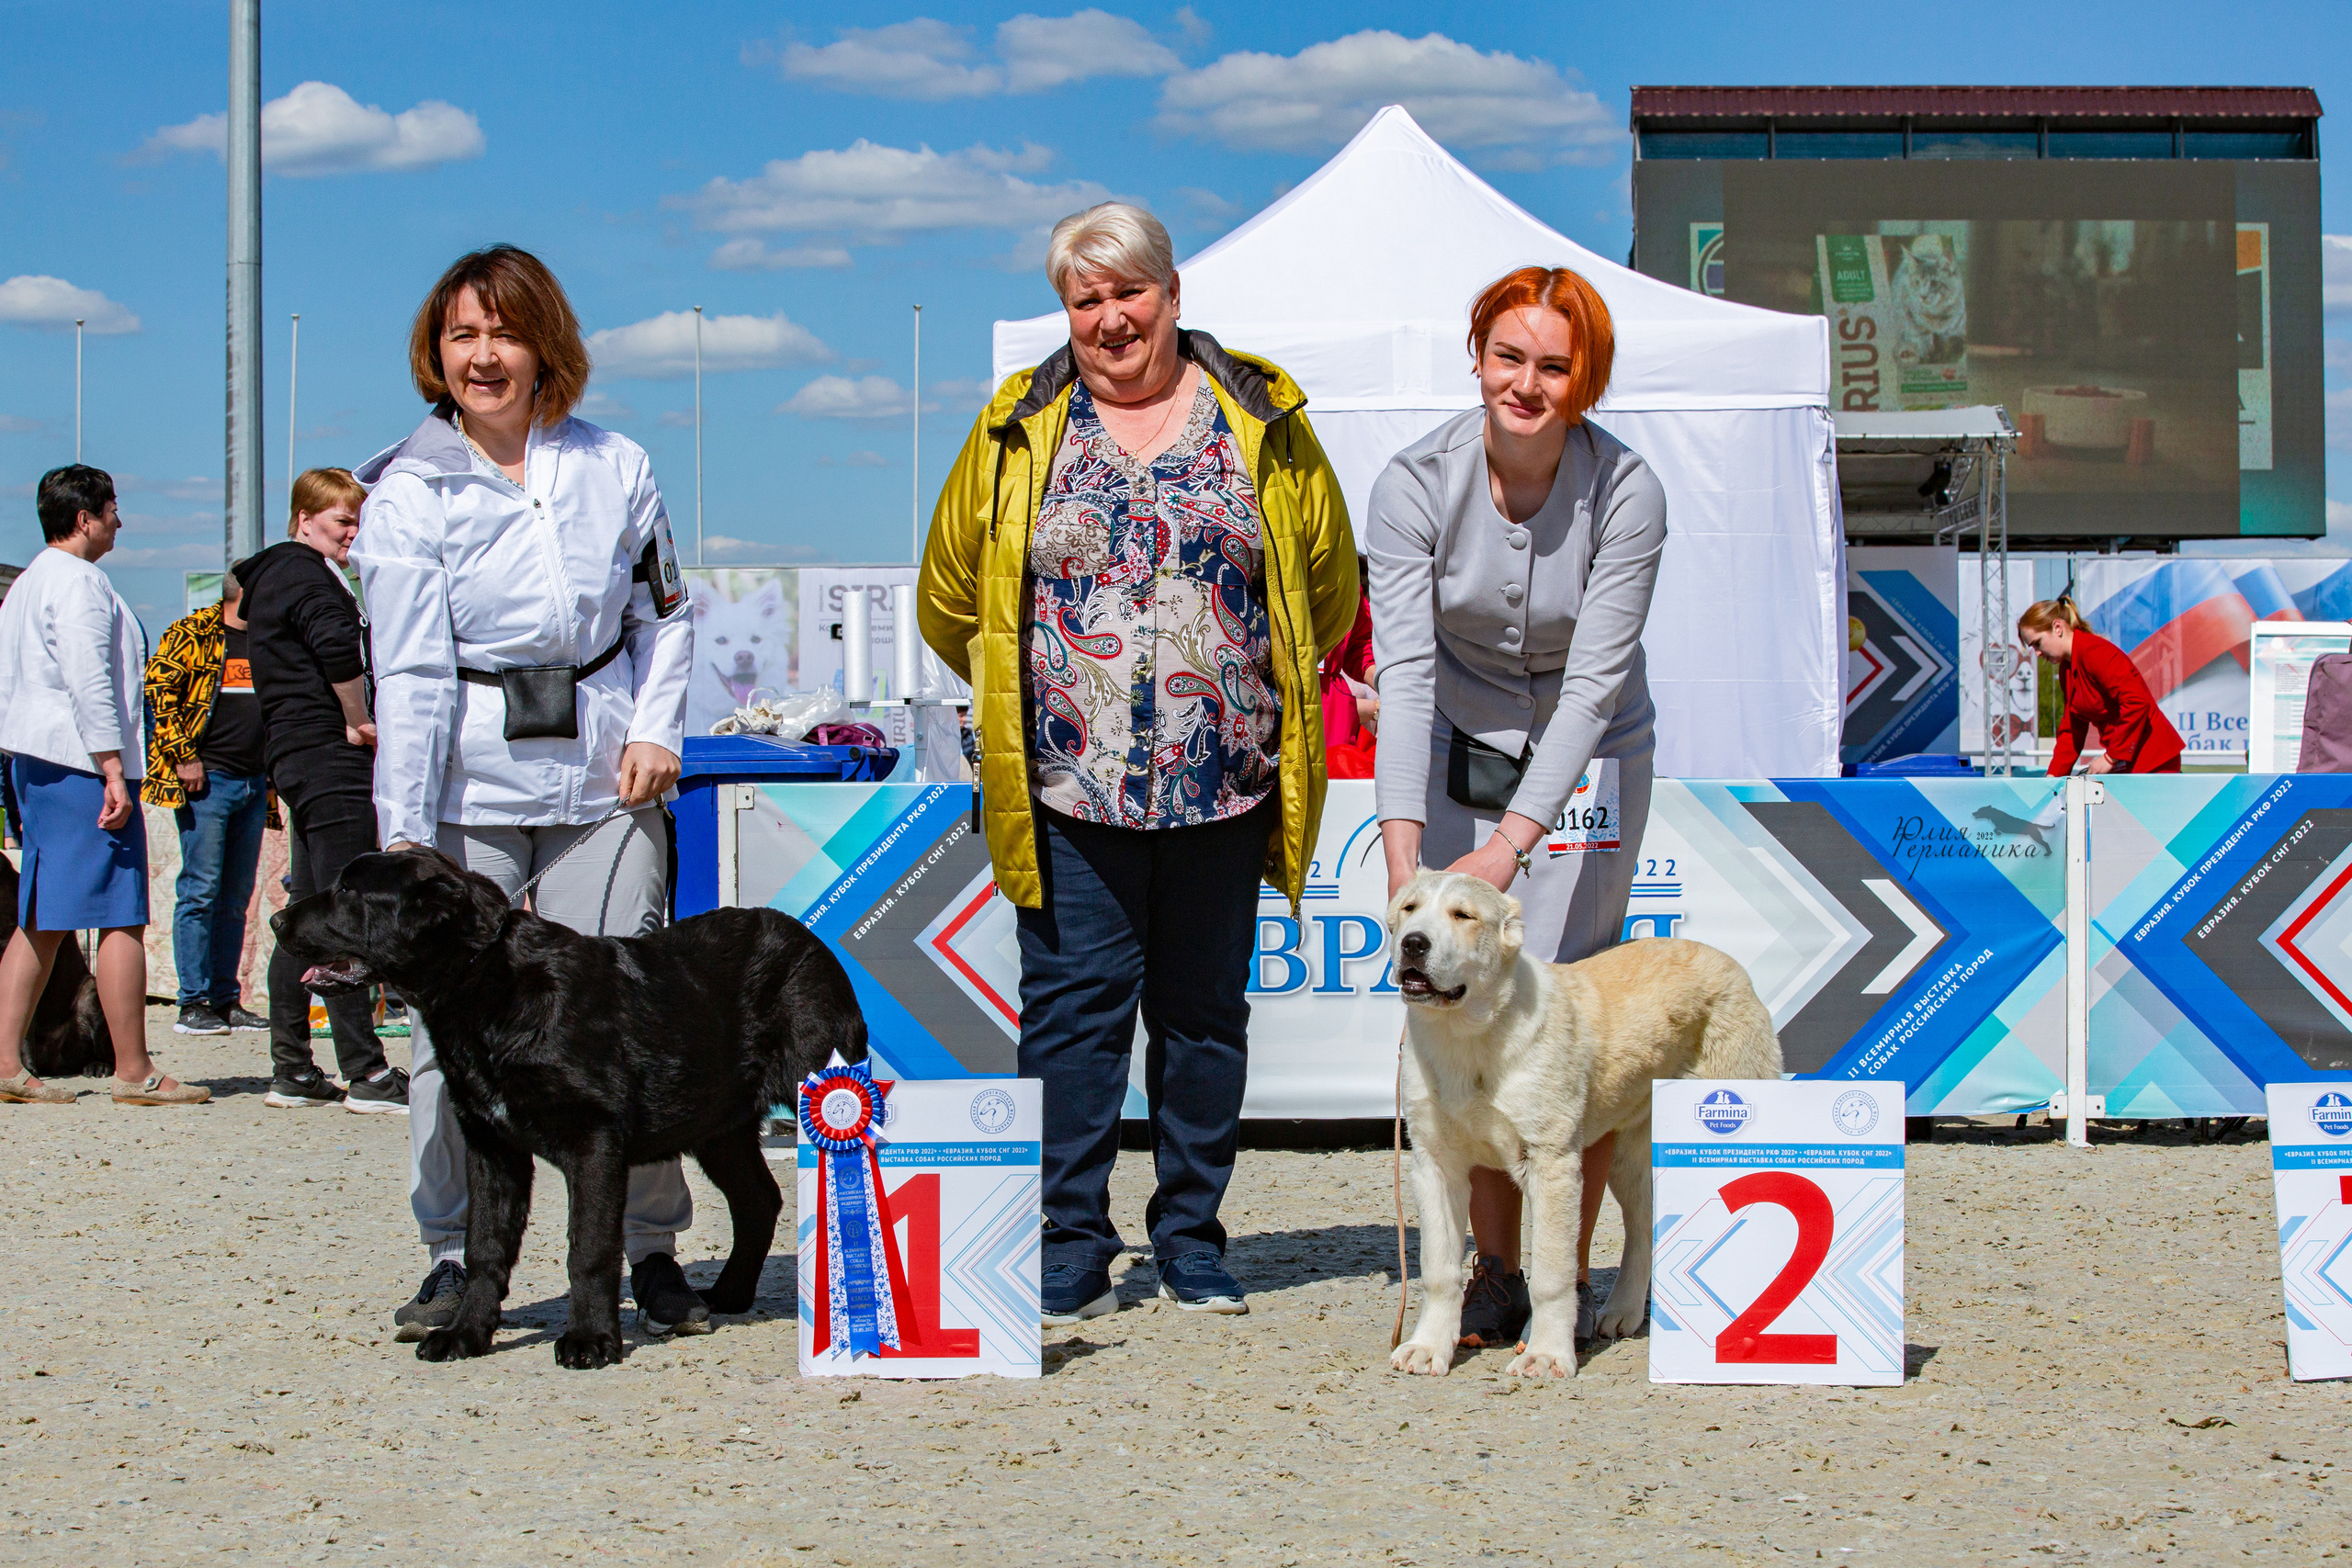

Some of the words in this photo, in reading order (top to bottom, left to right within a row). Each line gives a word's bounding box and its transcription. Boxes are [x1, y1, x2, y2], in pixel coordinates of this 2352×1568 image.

[1838, 270, 1865, 281] ADULT
[829, 874, 858, 904] КУБОК
[855, 822, 910, 875] ПРЕЗИДЕНТА
[907, 803, 927, 823] РКФ
[926, 782, 949, 805] 2022
[854, 897, 899, 940] ЕВРАЗИЯ.
[896, 864, 928, 896] КУБОК
[927, 844, 945, 864] СНГ
[945, 821, 970, 846] 2022
[1566, 842, 1599, 851] 21.05.2022
[2133, 902, 2175, 942] ЕВРАЗИЯ.
[2172, 873, 2201, 902] КУБОК
[2199, 820, 2254, 874] ПРЕЗИДЕНТА
[2251, 801, 2271, 822] РКФ
[2270, 779, 2293, 803] 2022
[2197, 896, 2242, 939] ЕВРАЗИЯ.
[2240, 862, 2272, 895] КУБОК
[2271, 842, 2290, 863] СНГ
[2289, 819, 2314, 845] 2022
[1848, 1066, 1860, 1078] II
[1859, 1011, 1915, 1067] ВСЕМИРНАЯ
[1914, 963, 1963, 1011] ВЫСТАВКА
[1868, 1043, 1900, 1076] СОБАК
[1899, 982, 1960, 1043] РОССИЙСКИХ
[1960, 948, 1994, 983] ПОРОД
[937, 1154, 978, 1162] РОССИЙСКИХ
[1698, 1106, 1747, 1118] Farmina
[868, 1174, 979, 1358] 1
[1715, 1171, 1837, 1364] 2
